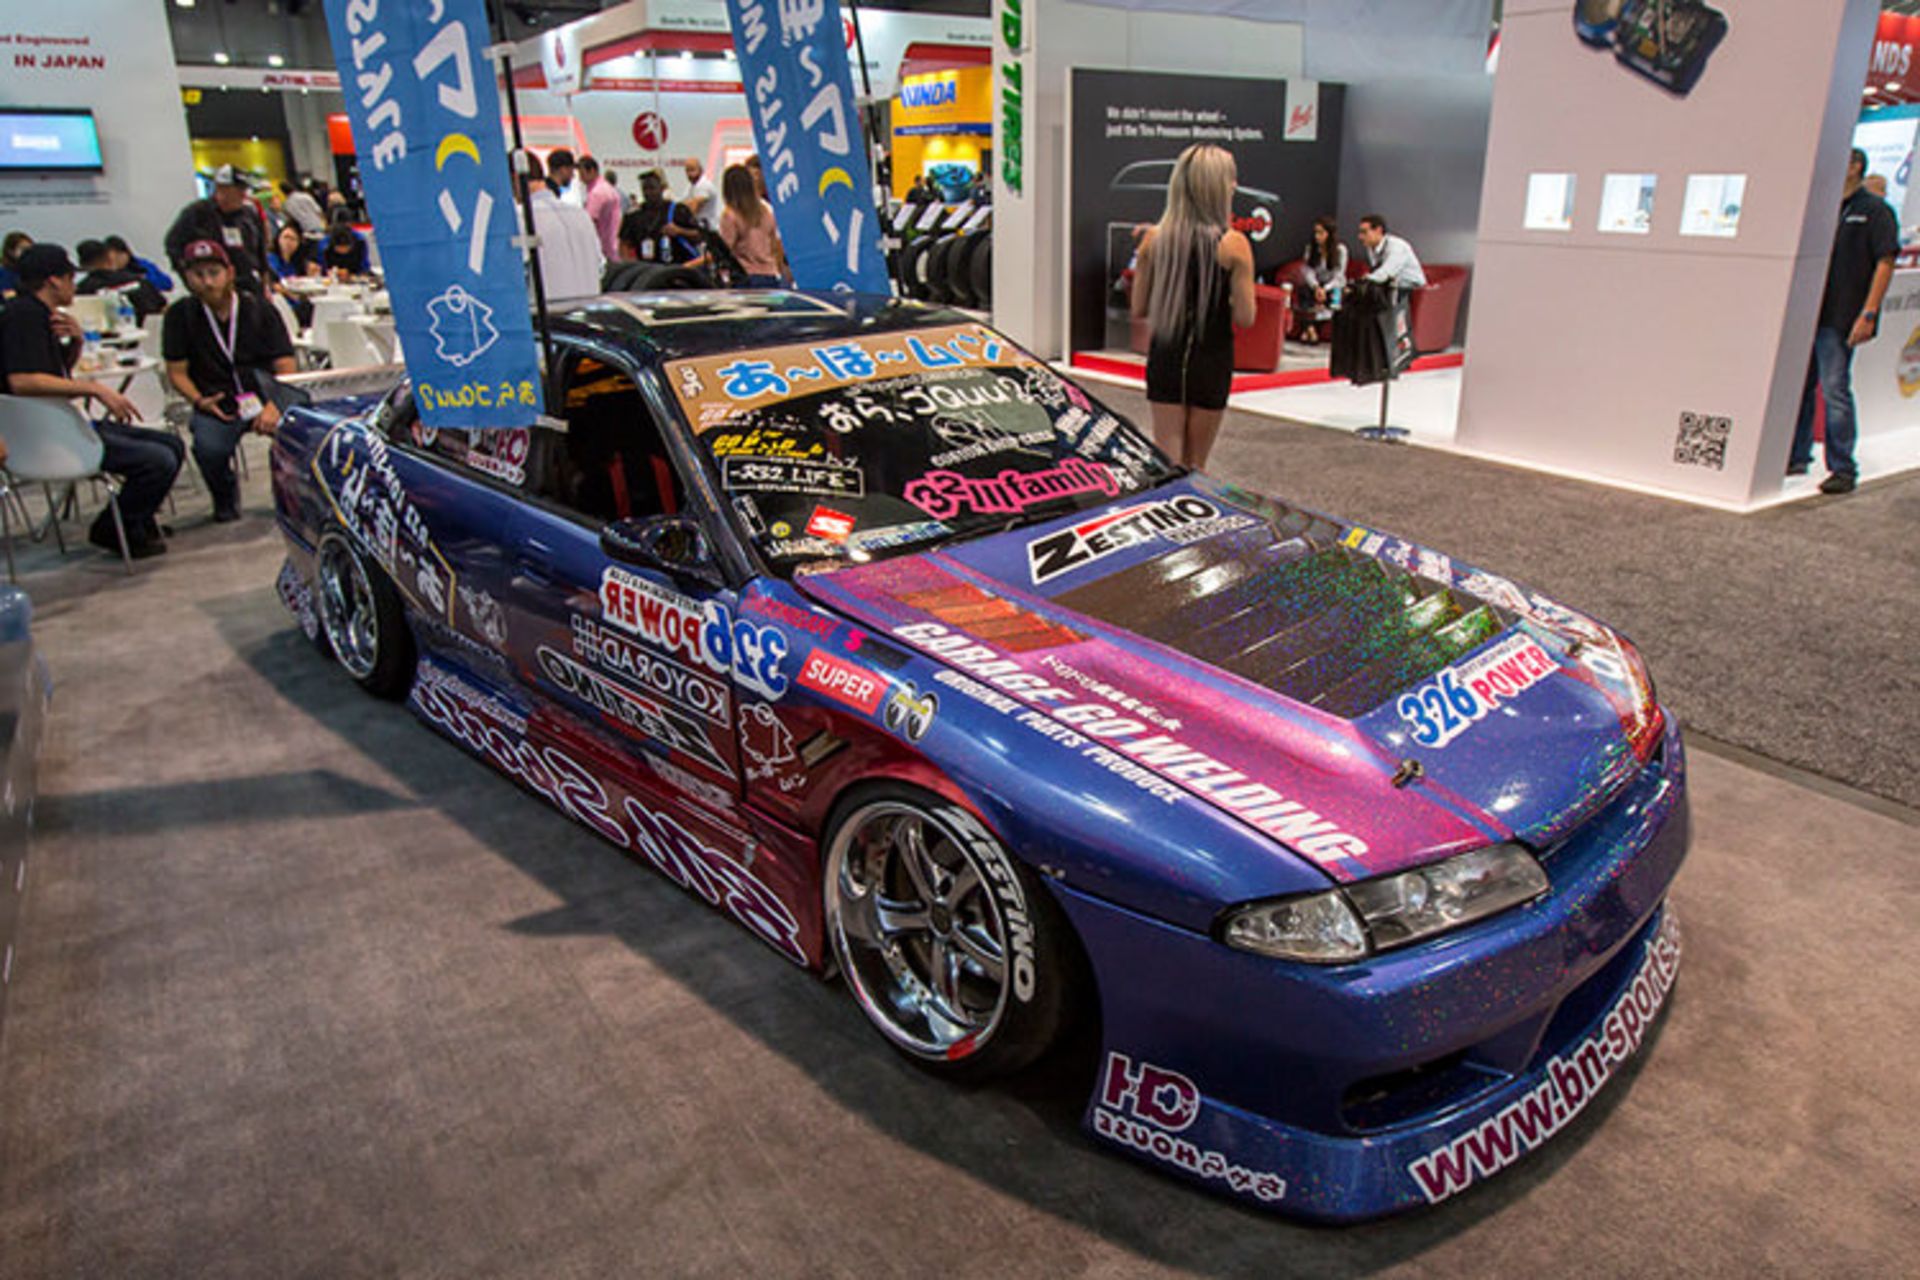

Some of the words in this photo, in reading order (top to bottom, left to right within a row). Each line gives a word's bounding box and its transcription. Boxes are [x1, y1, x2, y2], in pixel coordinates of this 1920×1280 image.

[14, 54, 36, 68] IN
[42, 54, 105, 70] JAPAN
[1002, 61, 1023, 197] TIRES
[1106, 106, 1120, 119] We
[1030, 496, 1217, 582] ZESTINO
[806, 659, 875, 702] SUPER
[1399, 668, 1482, 747] 326
[1471, 644, 1556, 706] POWER
[893, 621, 1077, 702] GARAGE
[1119, 735, 1369, 863] WELDING
[1015, 710, 1089, 748] PARTS
[932, 804, 1035, 1002] ZESTINO
